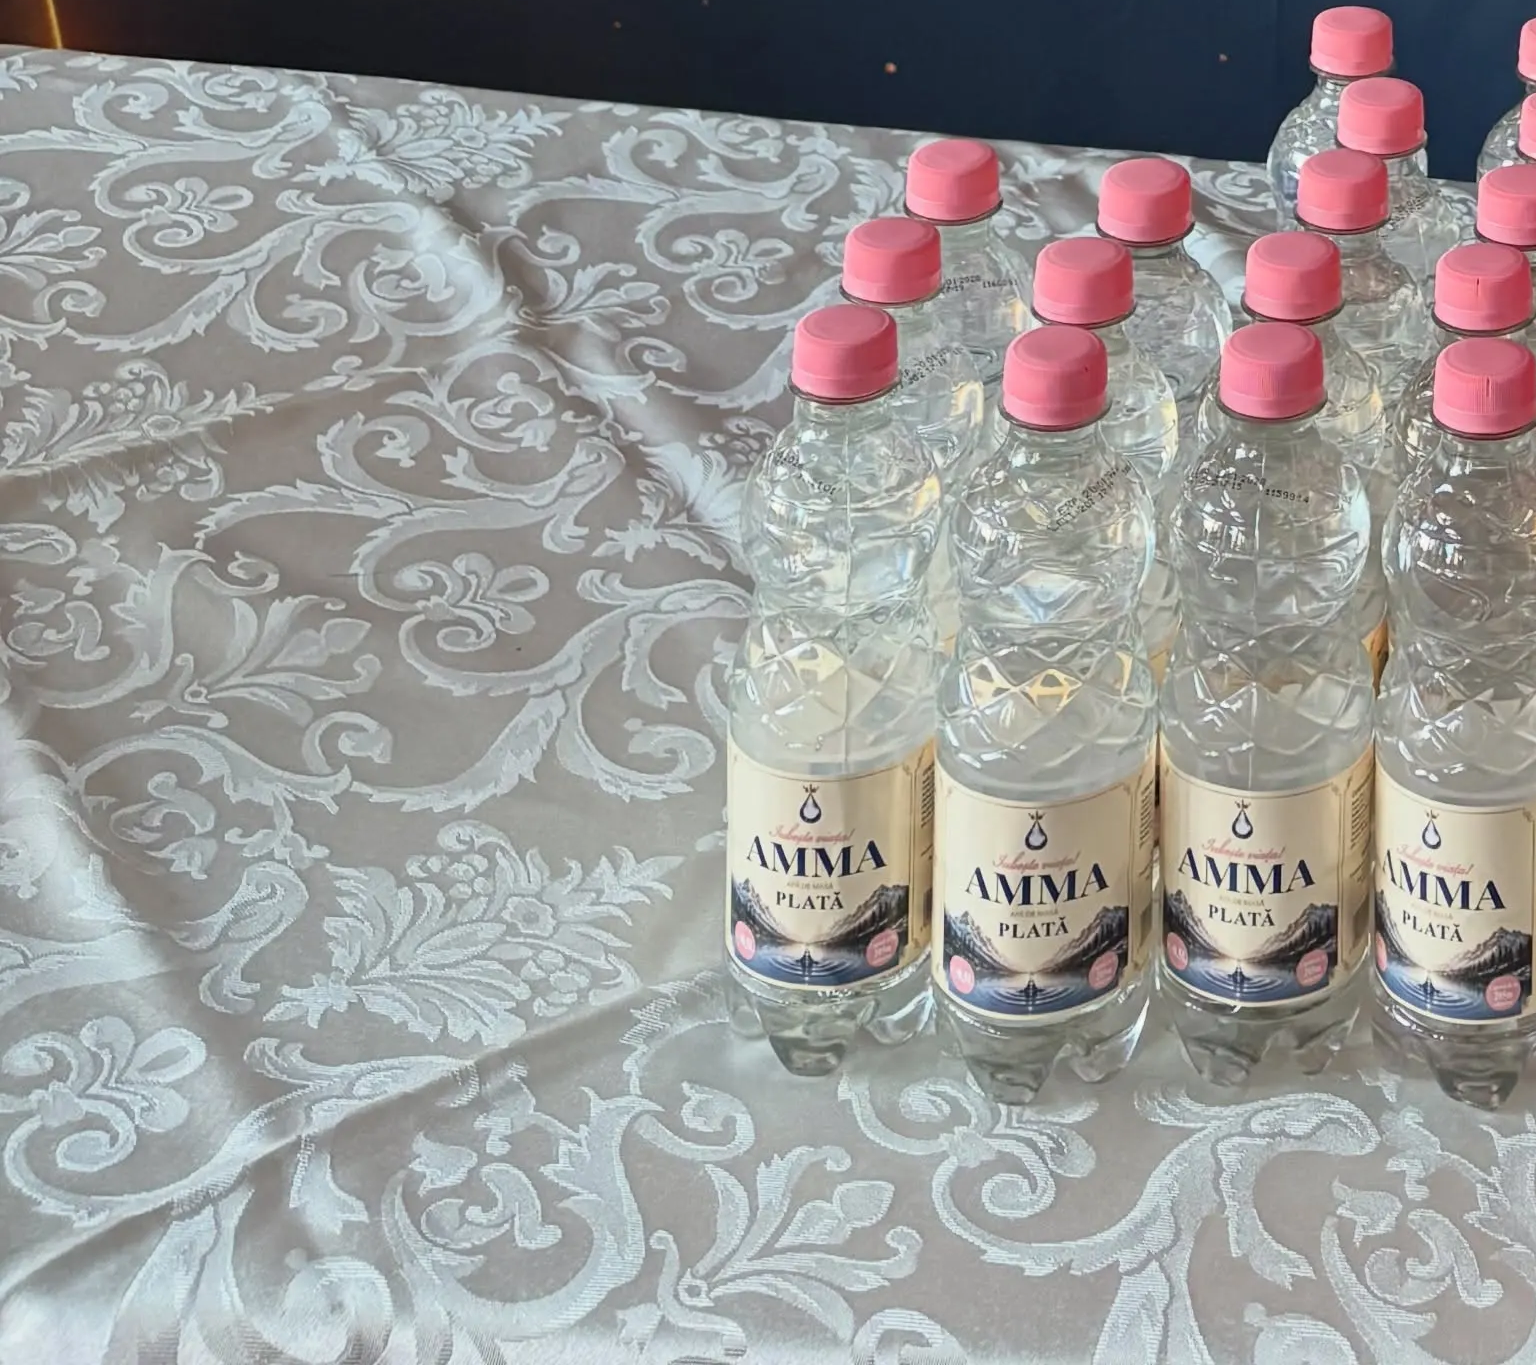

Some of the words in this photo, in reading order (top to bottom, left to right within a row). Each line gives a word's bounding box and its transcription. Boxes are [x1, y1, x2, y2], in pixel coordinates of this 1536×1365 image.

[746, 835, 888, 878] AMMA
[1178, 847, 1316, 896] AMMA
[965, 862, 1110, 906] AMMA
[1383, 849, 1507, 911] AMMA
[776, 891, 844, 910] PLATĂ
[1209, 904, 1275, 927] PLATĂ
[999, 917, 1069, 939] PLATĂ
[1402, 910, 1464, 943] PLATĂ
